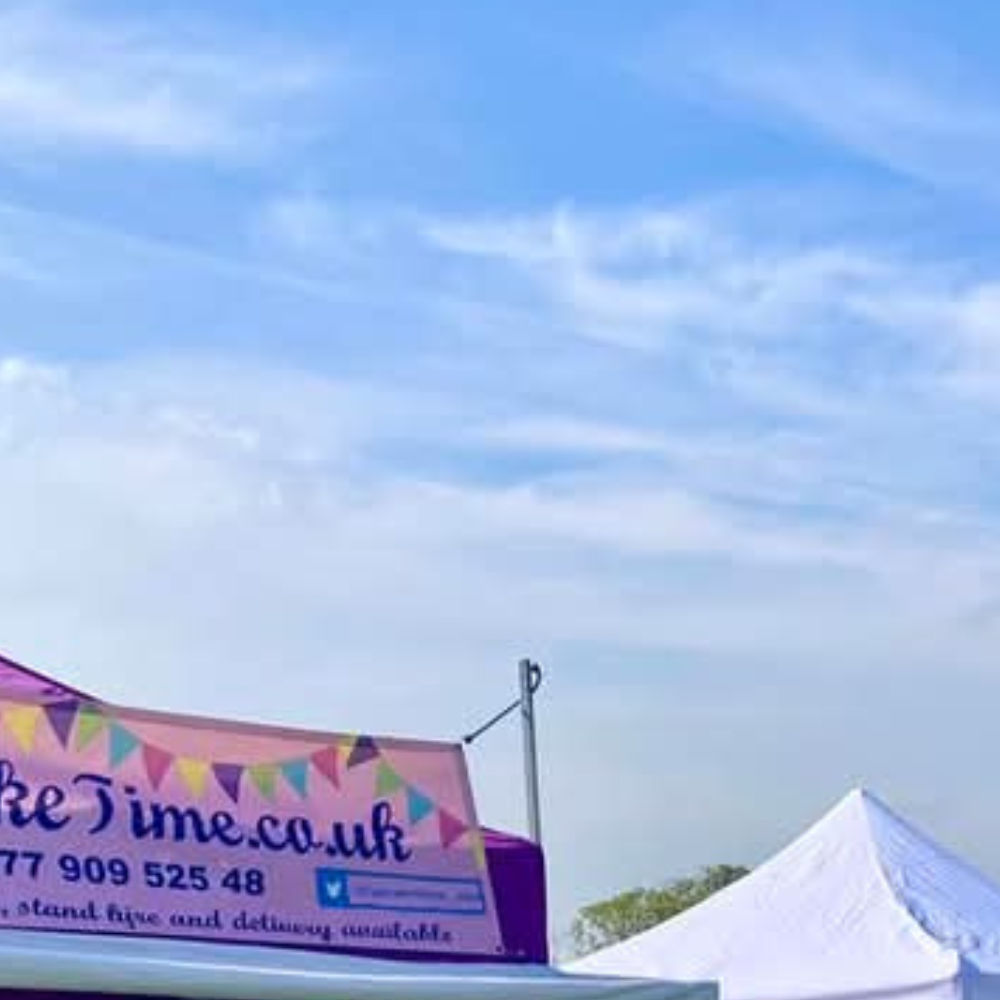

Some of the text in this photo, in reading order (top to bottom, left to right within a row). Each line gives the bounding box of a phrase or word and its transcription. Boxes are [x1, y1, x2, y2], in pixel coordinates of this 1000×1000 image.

[58, 854, 129, 890] 909
[144, 862, 209, 891] 525
[221, 868, 265, 895] 48
[18, 898, 98, 921] stand
[107, 903, 160, 929] hire
[170, 909, 223, 929] and
[233, 910, 331, 941] delivery
[341, 920, 453, 942] available
